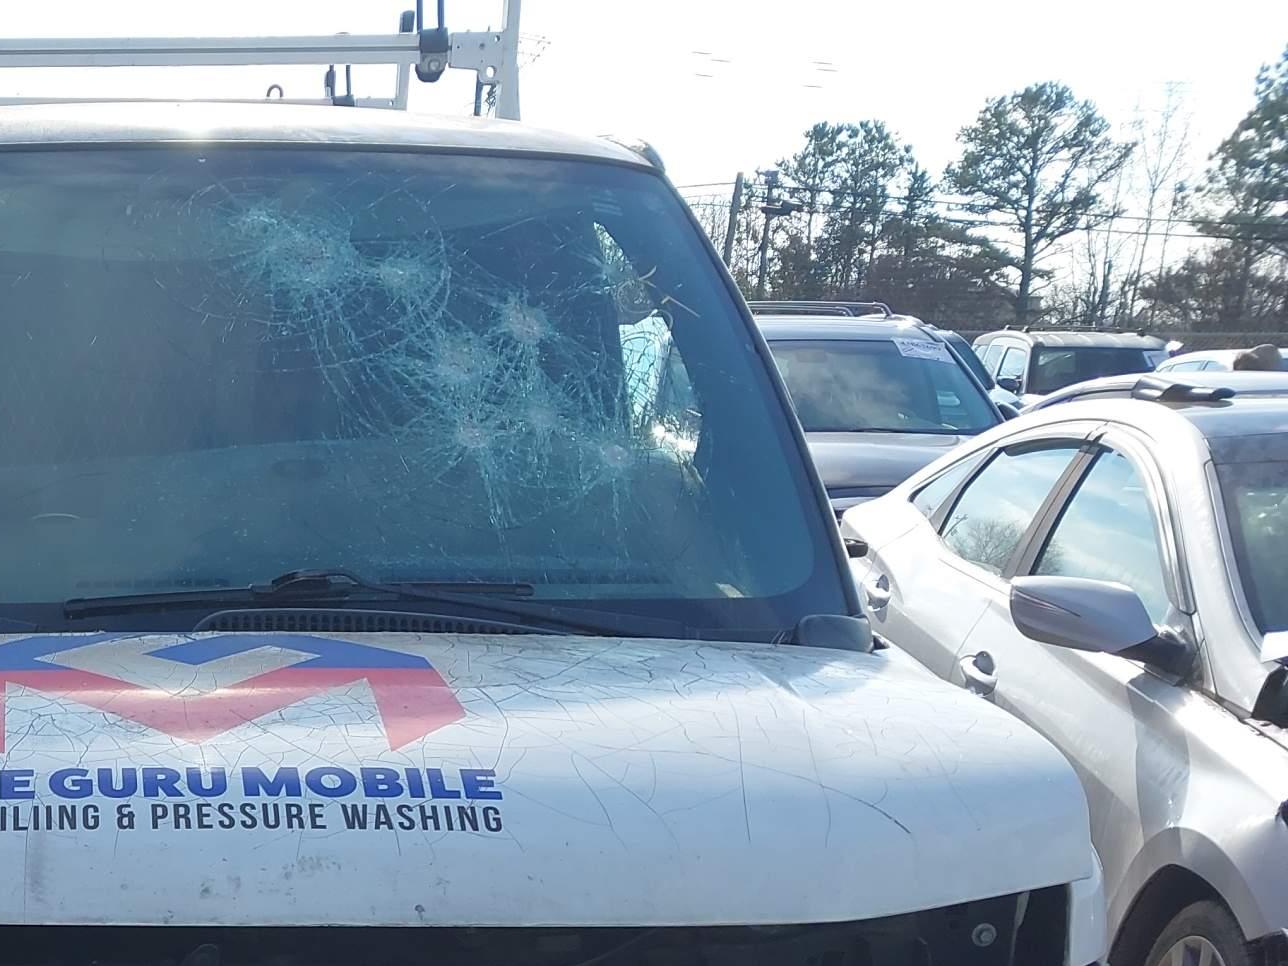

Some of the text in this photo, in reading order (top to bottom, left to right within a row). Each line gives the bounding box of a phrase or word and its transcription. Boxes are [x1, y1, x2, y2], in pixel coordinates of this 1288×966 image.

[48, 767, 228, 799] GURU
[241, 766, 503, 800] MOBILE
[116, 803, 136, 830] &
[151, 802, 328, 830] PRESSURE
[341, 803, 503, 833] WASHING
